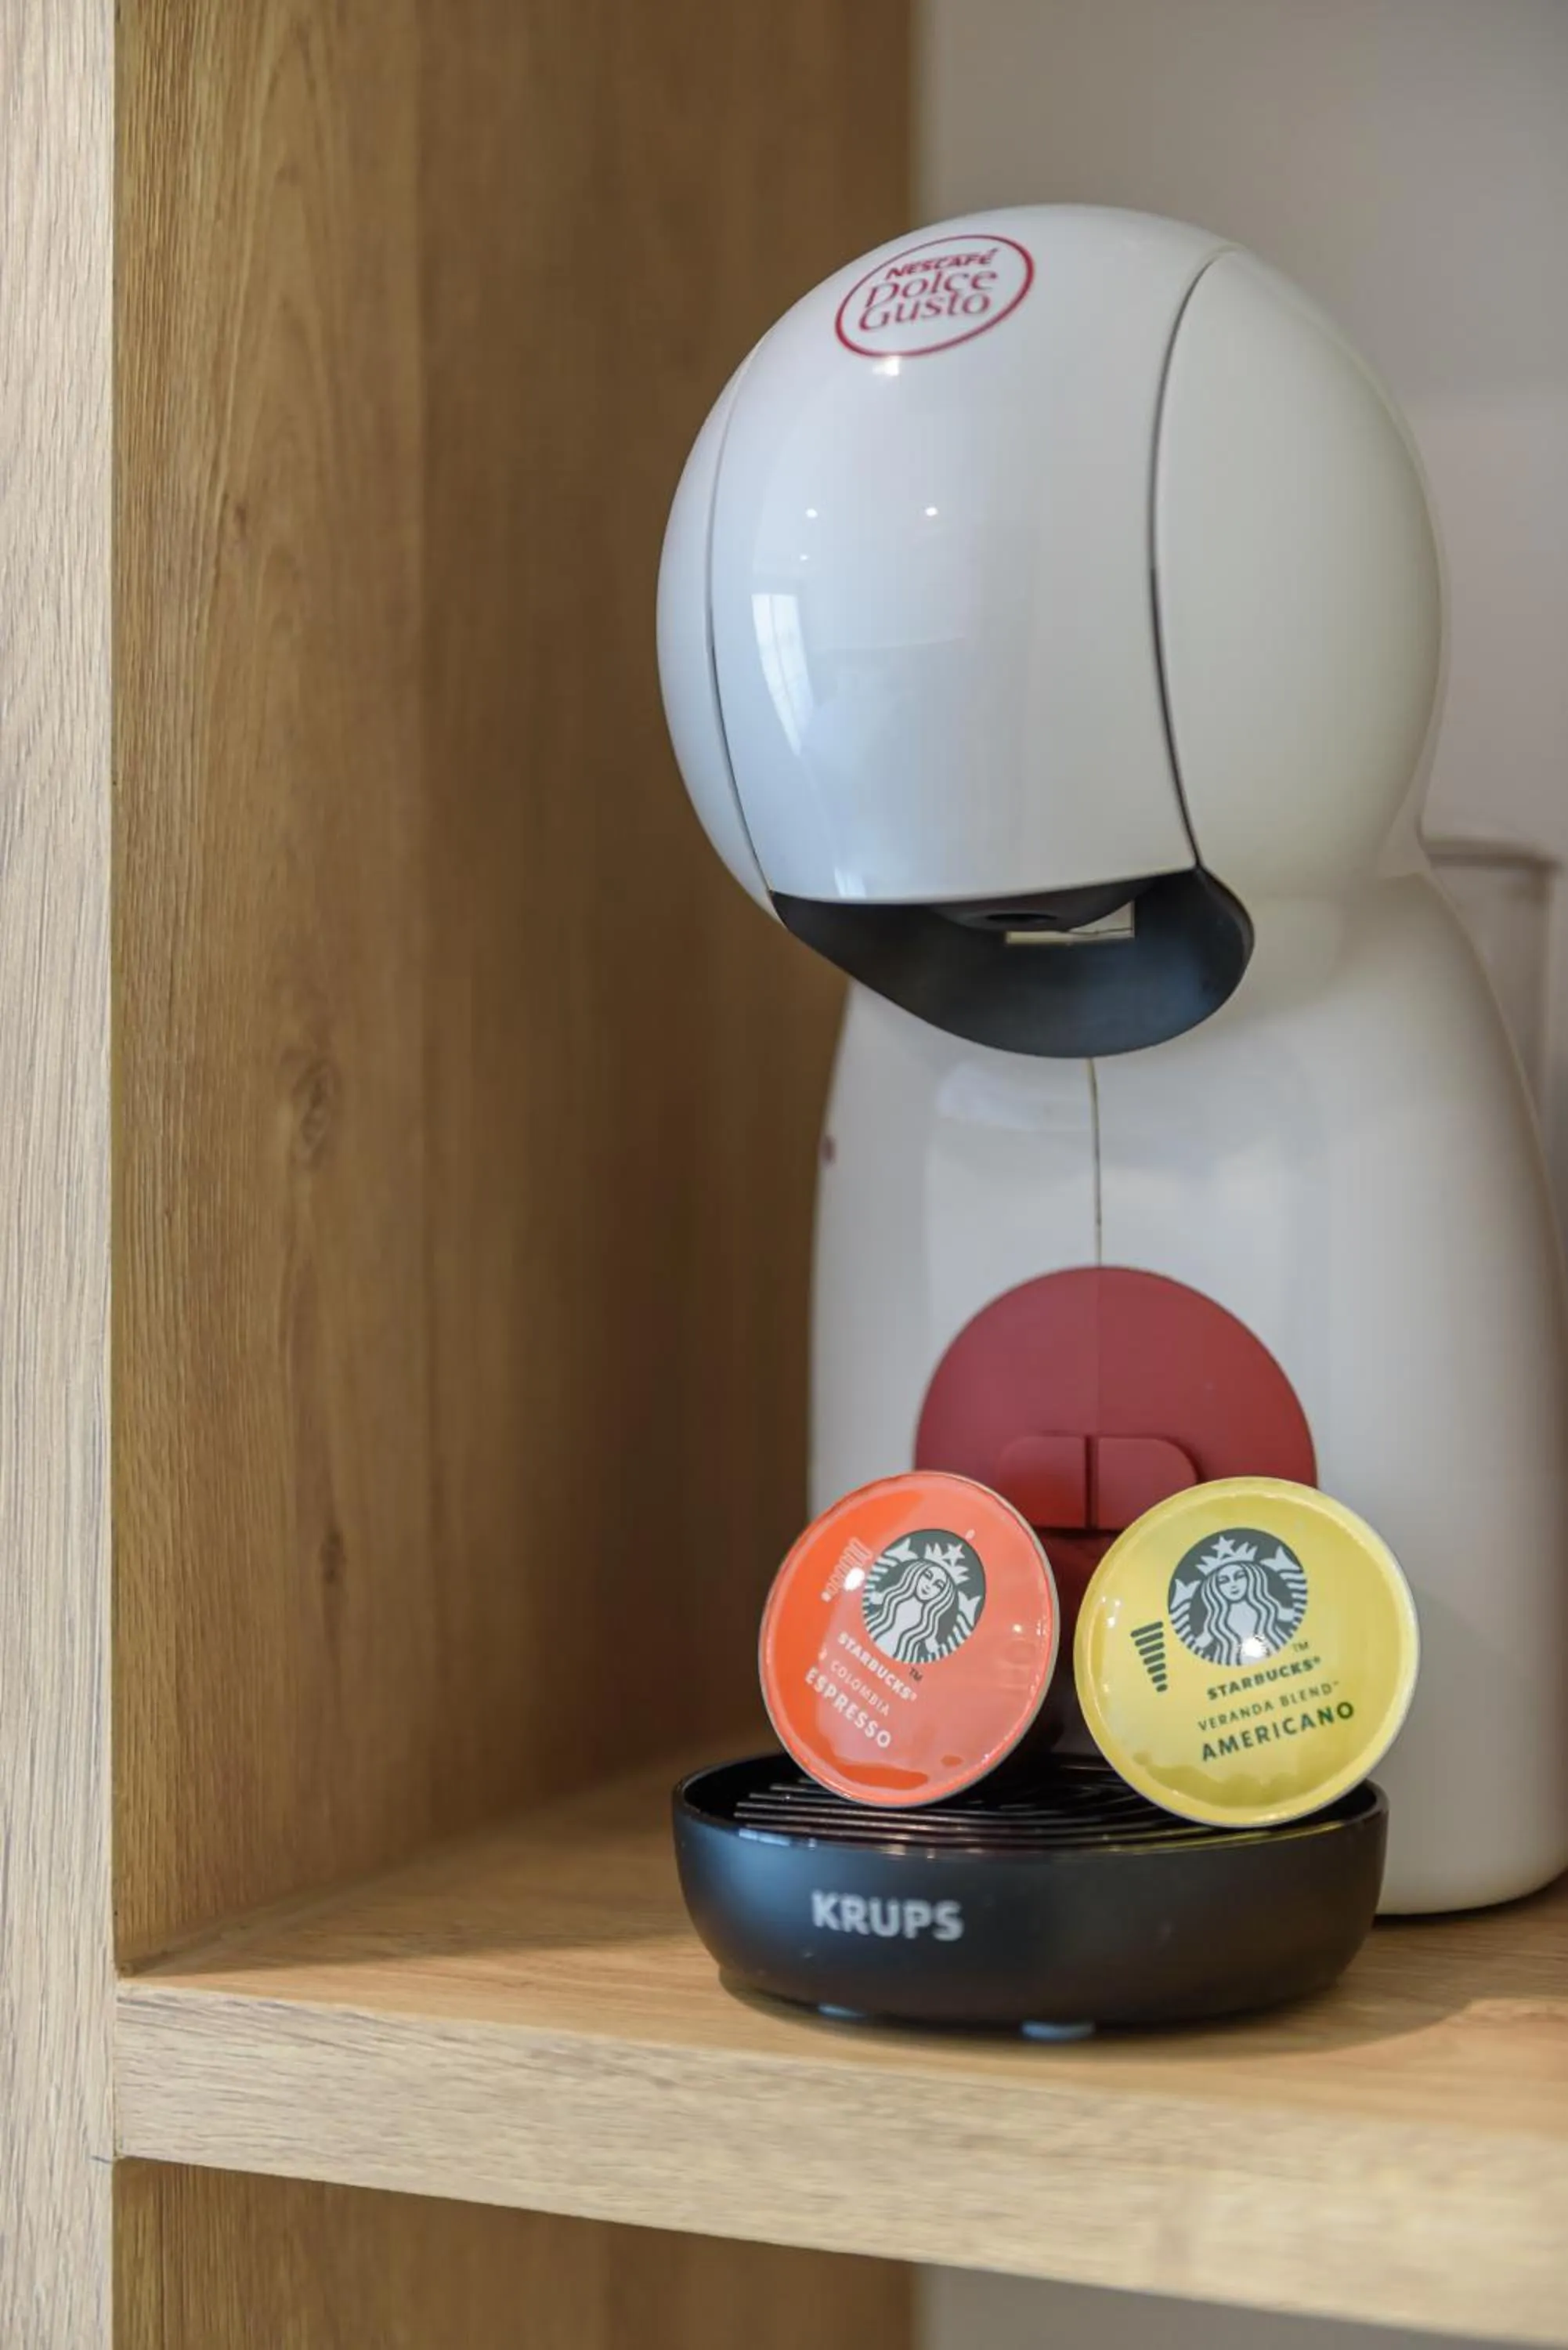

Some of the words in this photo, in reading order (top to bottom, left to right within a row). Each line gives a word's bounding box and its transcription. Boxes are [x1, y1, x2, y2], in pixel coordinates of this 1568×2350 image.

[858, 290, 991, 331] Gusto
[865, 270, 999, 308] Dolce
[805, 1666, 892, 1748] ESPRESSO
[830, 1659, 891, 1717] COLOMBIA
[1198, 1700, 1274, 1731] VERANDA
[1202, 1701, 1354, 1761] AMERICANO
[811, 1889, 965, 1942] KRUPS
